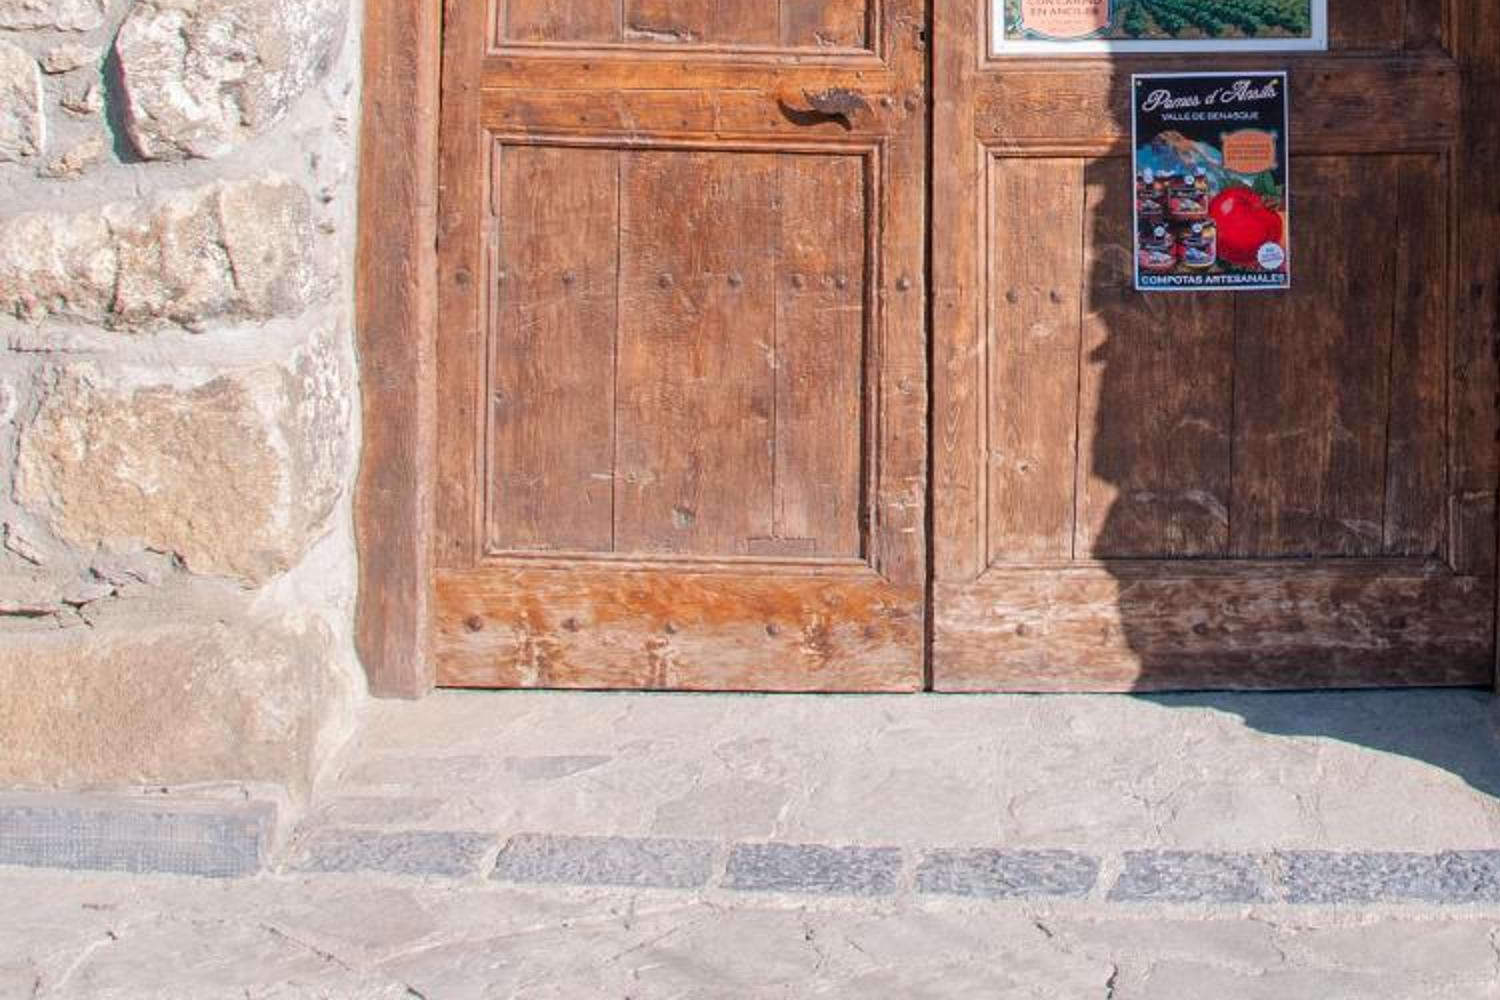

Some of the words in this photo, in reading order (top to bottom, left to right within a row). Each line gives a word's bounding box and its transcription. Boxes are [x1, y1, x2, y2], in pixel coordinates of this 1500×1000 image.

[1141, 89, 1200, 112] Pomes
[1161, 111, 1190, 121] VALLE
[1191, 111, 1205, 121] DE
[1207, 111, 1260, 121] BENASQUE
[1141, 275, 1203, 285] COMPOTAS
[1205, 273, 1285, 284] ARTESANALES
